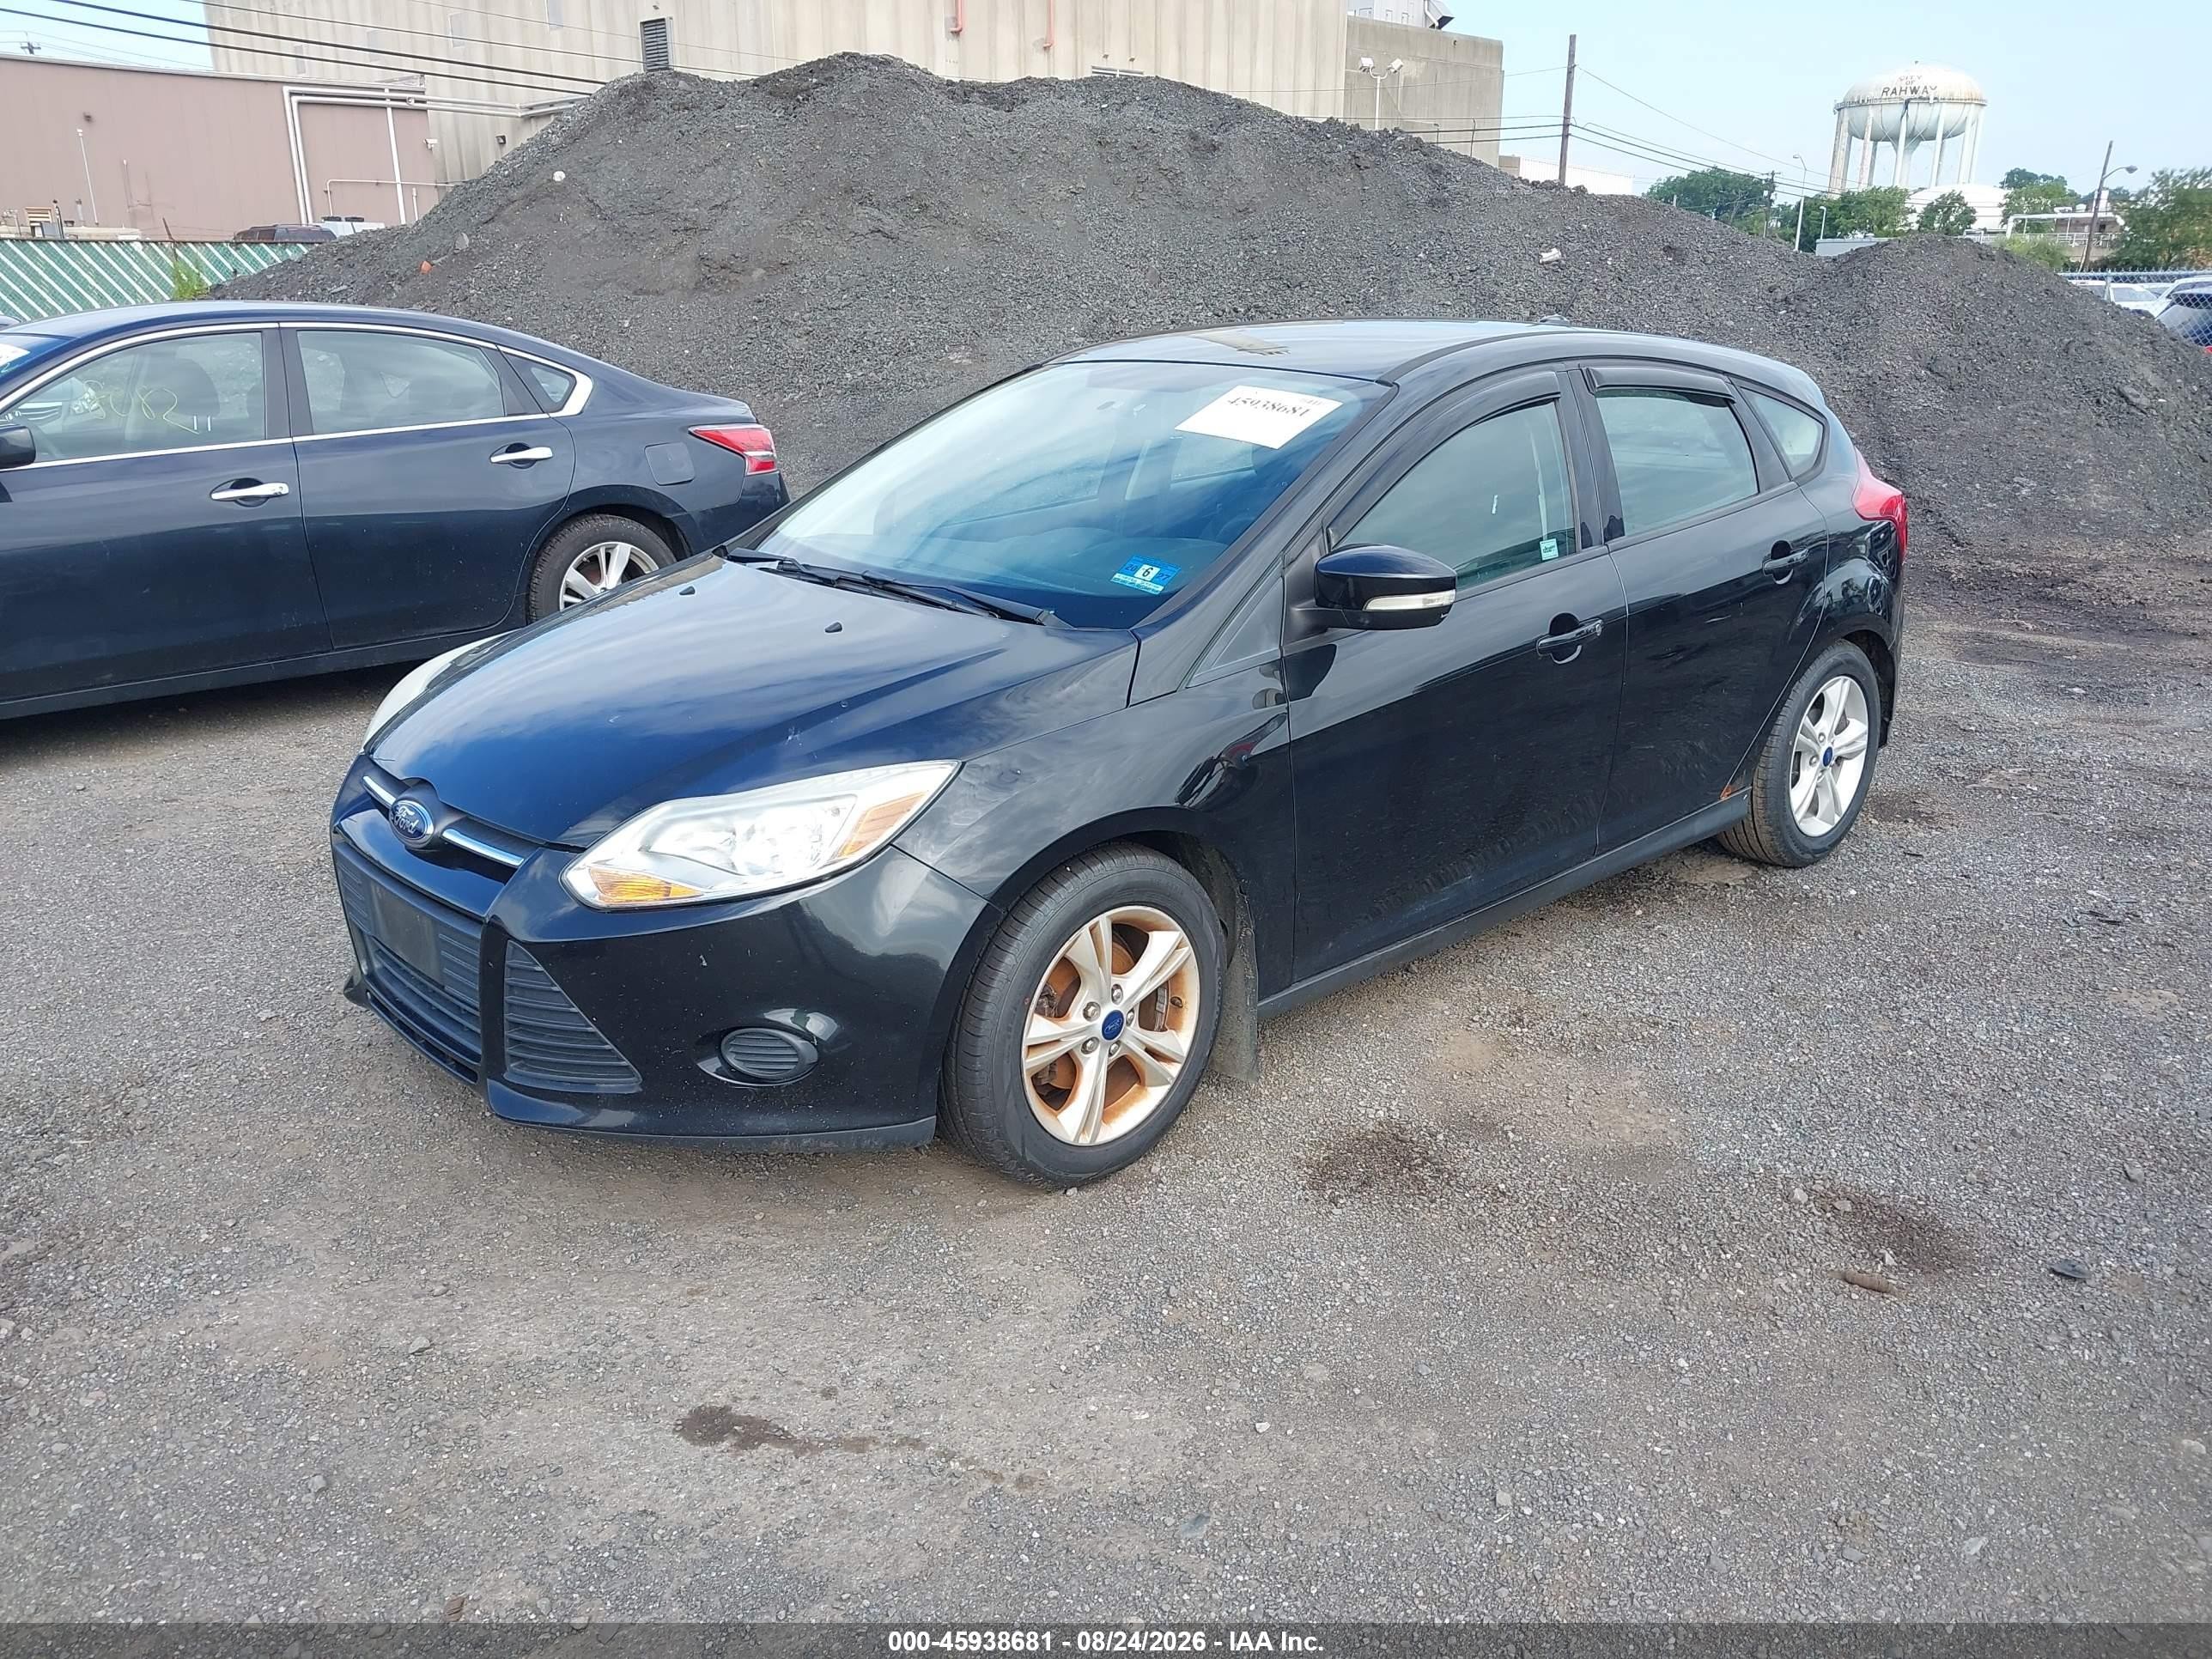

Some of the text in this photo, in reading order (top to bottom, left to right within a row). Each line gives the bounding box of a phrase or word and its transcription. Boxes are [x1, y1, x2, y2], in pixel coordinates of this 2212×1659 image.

[1881, 85, 1938, 97] RAHWAY
[1142, 567, 1154, 578] 6
[393, 805, 420, 835] Ford
